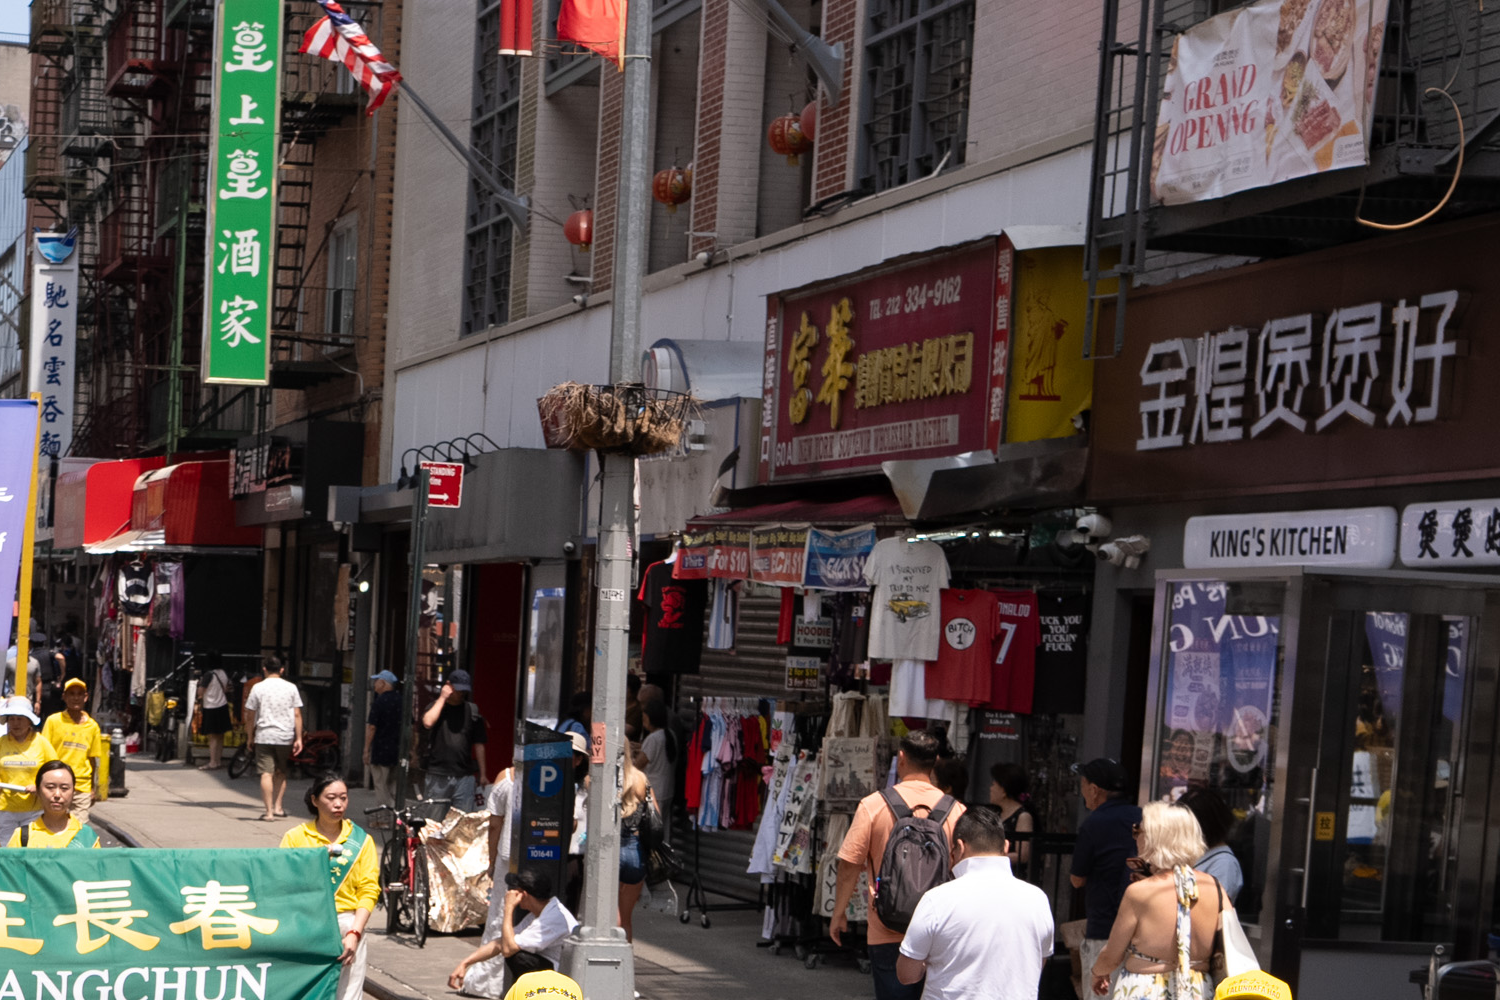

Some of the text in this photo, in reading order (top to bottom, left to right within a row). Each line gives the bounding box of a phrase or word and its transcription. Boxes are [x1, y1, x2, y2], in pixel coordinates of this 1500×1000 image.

[886, 275, 963, 316] 212 334-9162
[1210, 525, 1349, 558] KING'S KITCHEN
[730, 549, 747, 574] $10
[896, 565, 932, 576] SURVIVED
[903, 576, 913, 584] MY
[889, 584, 930, 593] TRIP TO NYC
[1063, 615, 1083, 625] YOU
[796, 626, 831, 637] HOODIE
[947, 623, 975, 635] BITCH
[1049, 625, 1069, 634] YOU
[803, 637, 815, 645] for
[956, 634, 964, 645] 1
[995, 622, 1018, 665] 7
[1045, 643, 1073, 652] FUCK
[794, 668, 804, 676] for
[805, 669, 818, 677] $14
[794, 678, 804, 687] for
[805, 679, 818, 687] $20
[539, 765, 557, 792] P
[536, 820, 560, 828] ParkNYC
[530, 848, 554, 858] 101641
